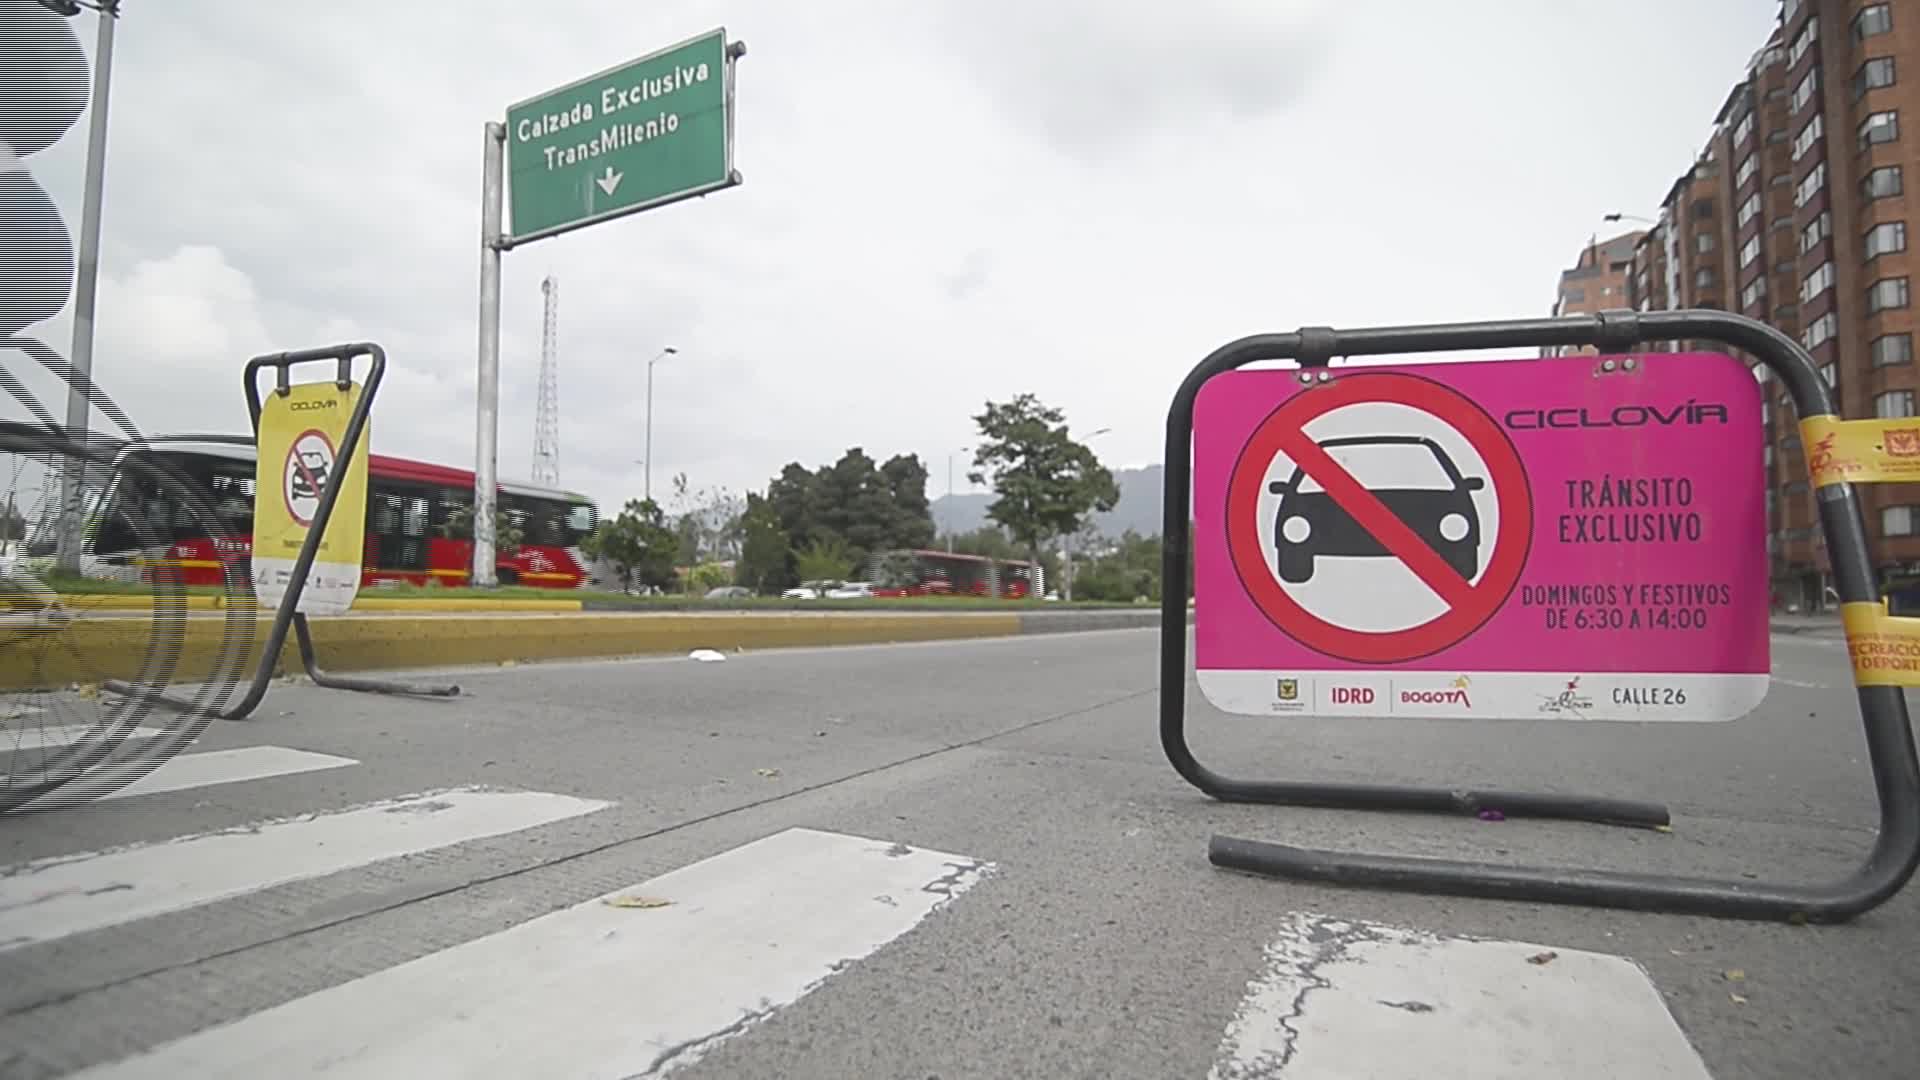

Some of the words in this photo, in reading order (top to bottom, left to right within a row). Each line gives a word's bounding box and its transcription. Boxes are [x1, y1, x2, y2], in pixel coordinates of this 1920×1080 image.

[518, 101, 593, 142] Calzada
[601, 63, 709, 115] Exclusiva
[544, 112, 679, 170] TransMilenio
[1504, 398, 1729, 429] CICLOVÍA
[1565, 474, 1693, 508] TRÁNSITO
[1558, 513, 1702, 543] EXCLUSIVO
[1521, 584, 1617, 606] DOMINGOS
[1622, 584, 1634, 605] Y
[1640, 583, 1731, 605] FESTIVOS
[1546, 608, 1569, 629] DE
[1574, 608, 1624, 629] 6:30
[1628, 609, 1641, 629] A
[1647, 608, 1708, 629] 14:00
[1331, 687, 1375, 704] IDRD
[1612, 687, 1660, 705] CALLE
[1663, 687, 1687, 705] 26
